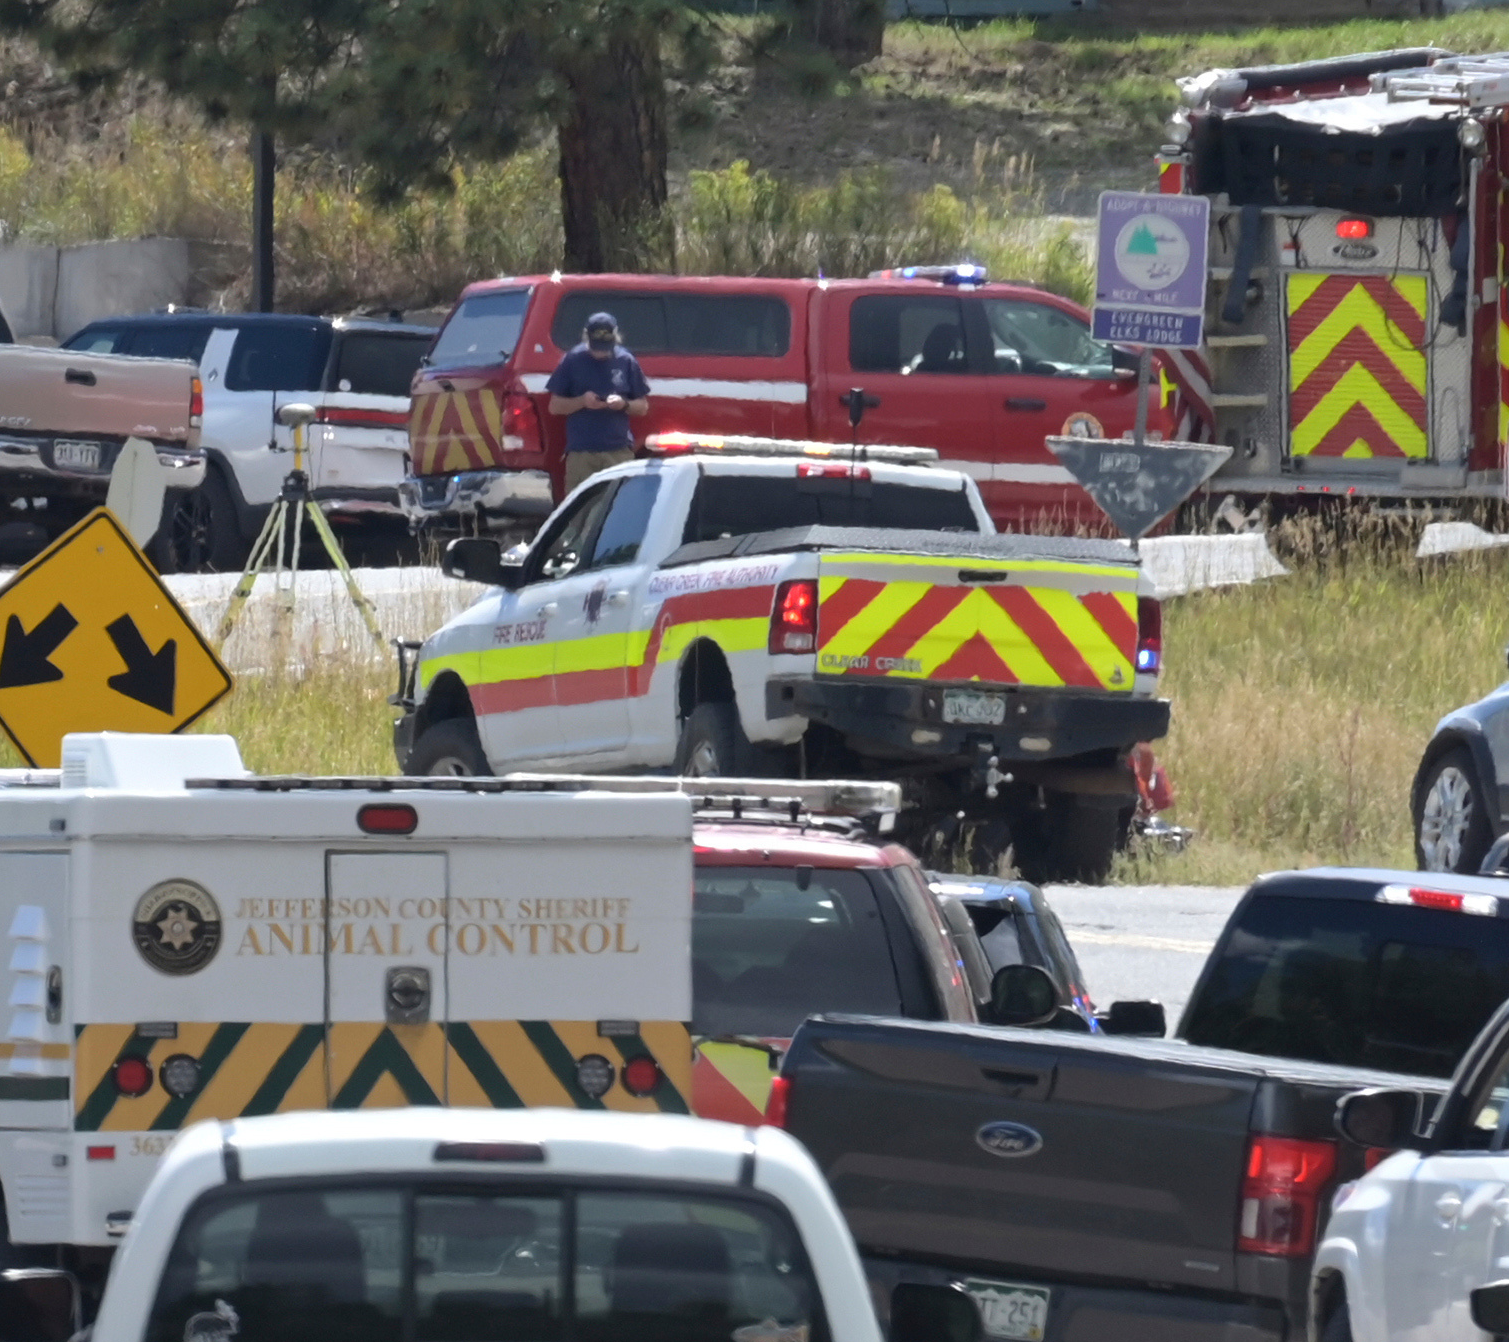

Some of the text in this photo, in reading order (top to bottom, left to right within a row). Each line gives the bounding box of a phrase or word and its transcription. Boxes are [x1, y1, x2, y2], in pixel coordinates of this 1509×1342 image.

[1111, 311, 1184, 328] EVERGREEN
[1110, 325, 1183, 343] ELKS LODGE
[821, 653, 923, 673] CLEAR CREEK
[234, 895, 391, 921] JEFFERSON
[398, 896, 509, 921] COUNTY
[517, 896, 634, 920] SHERIFF
[234, 921, 642, 959] ANIMAL CONTROL
